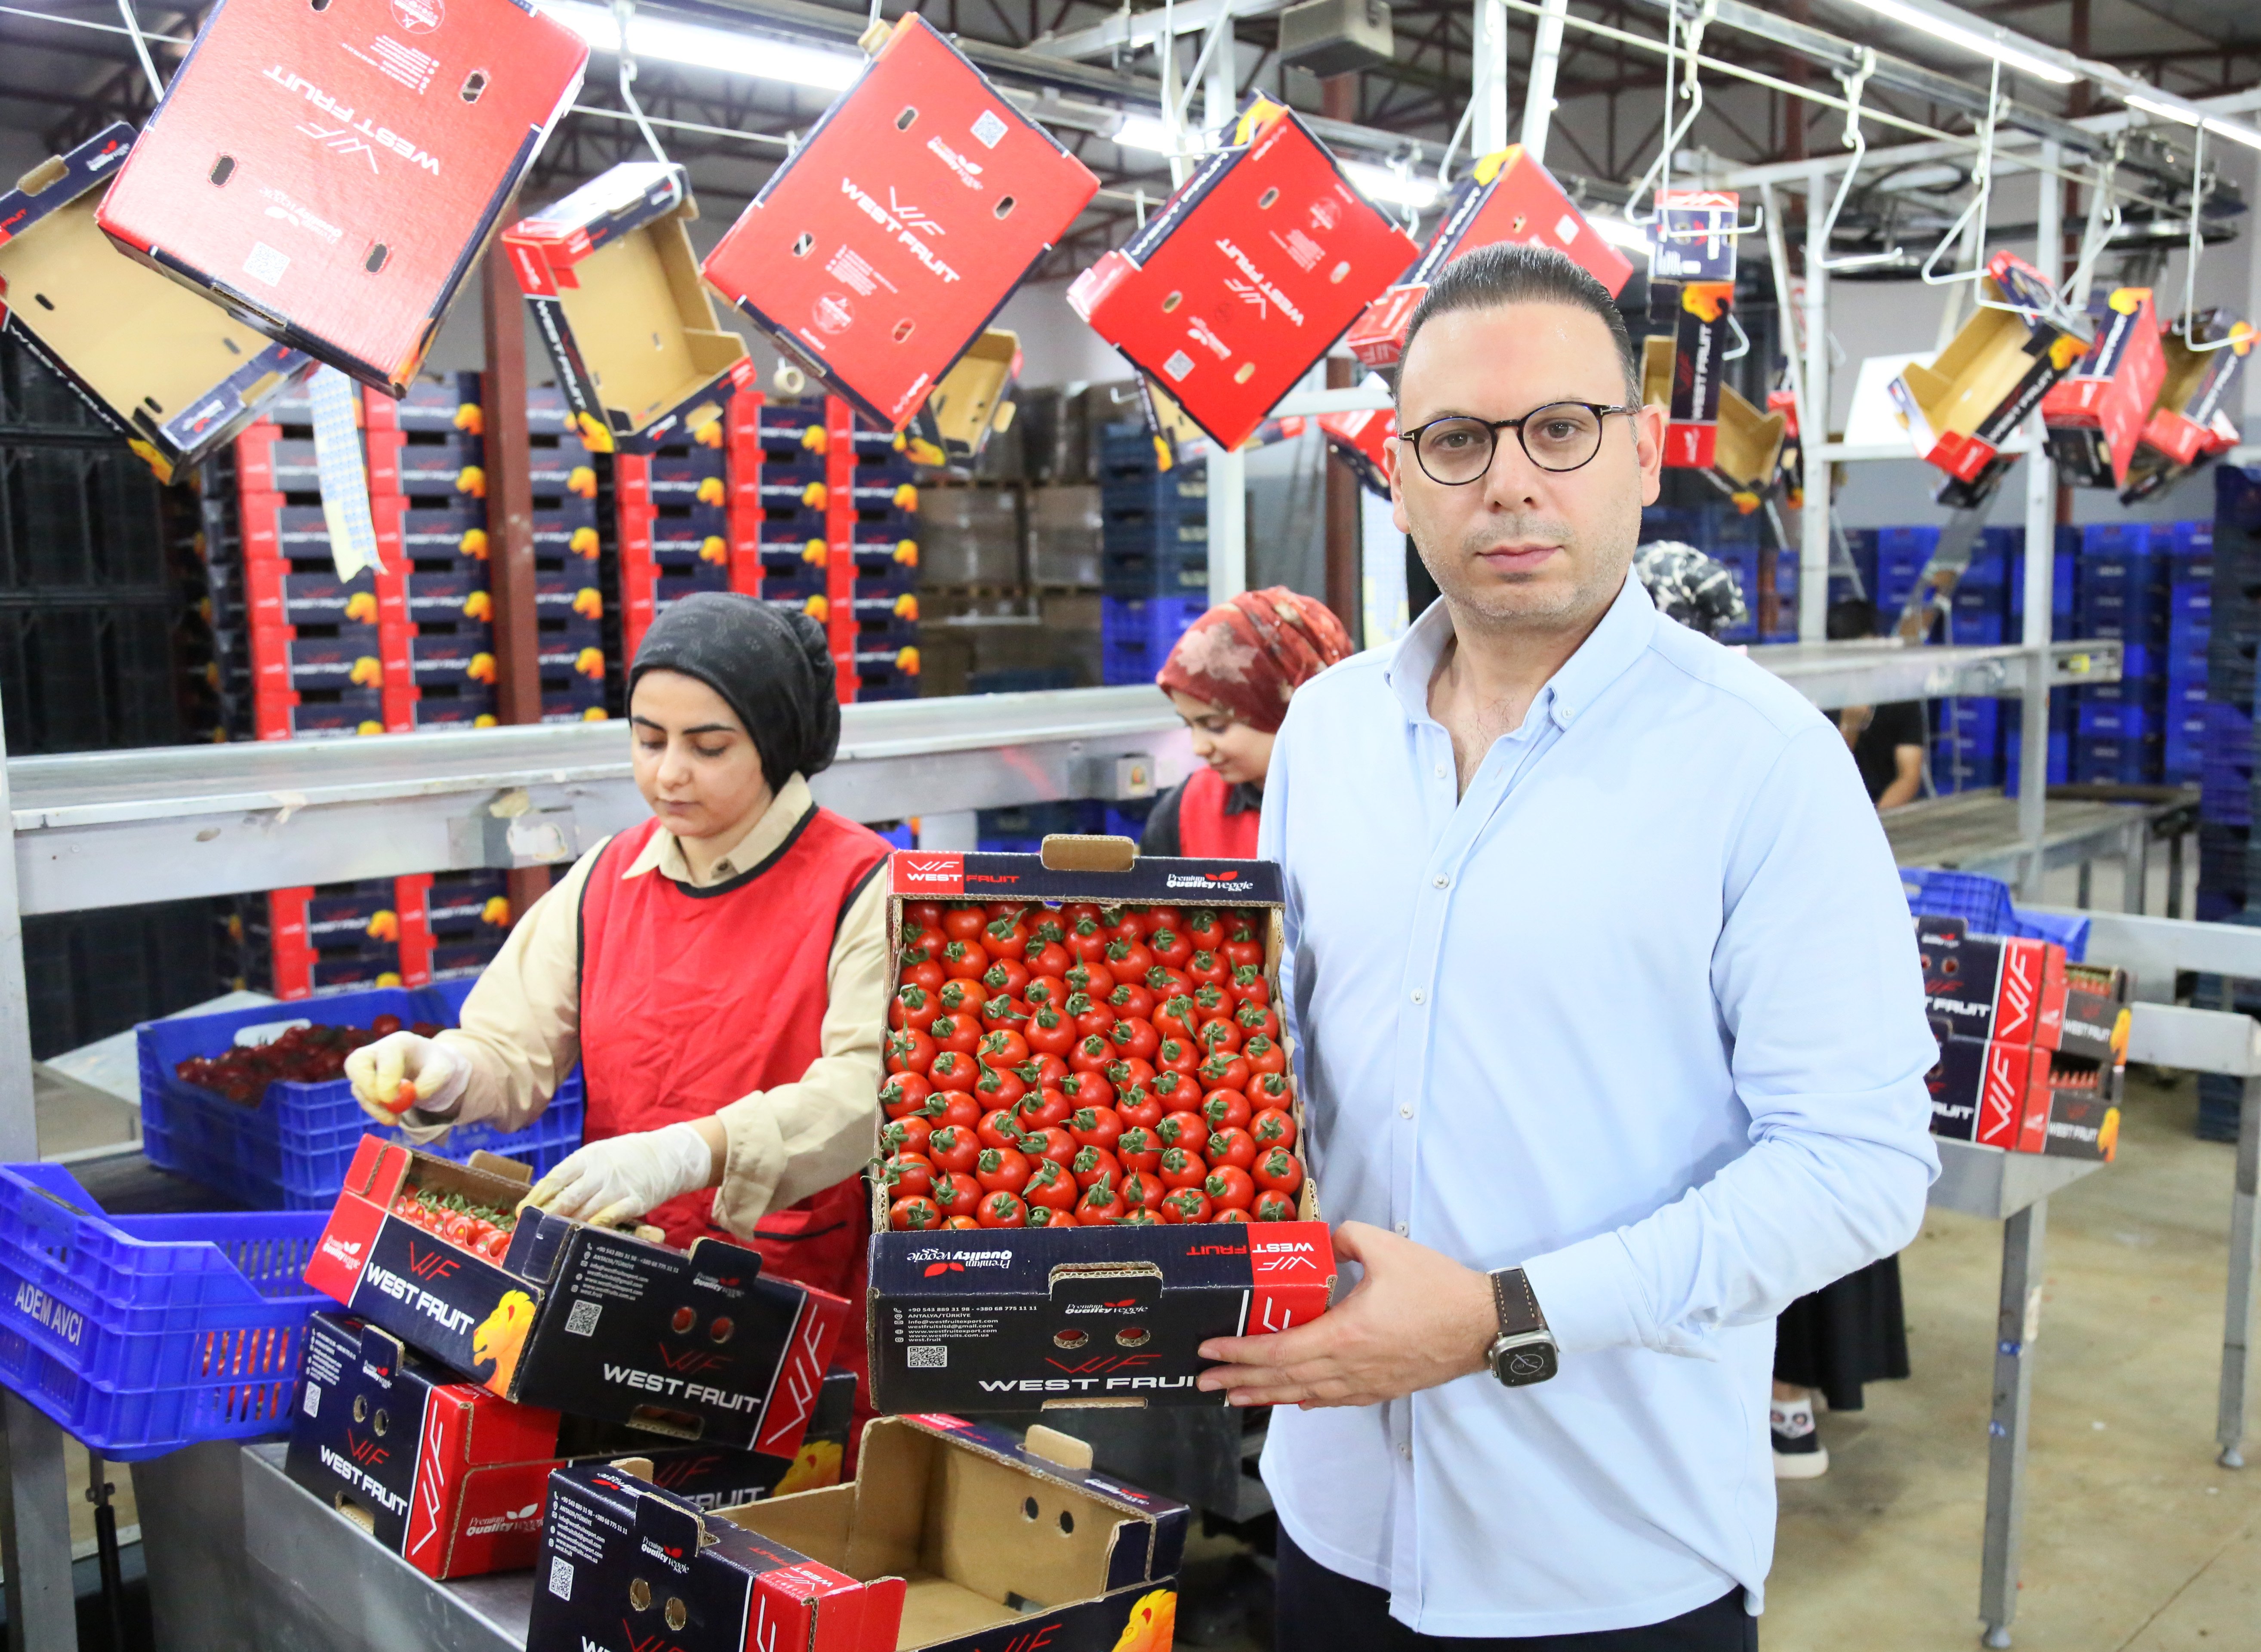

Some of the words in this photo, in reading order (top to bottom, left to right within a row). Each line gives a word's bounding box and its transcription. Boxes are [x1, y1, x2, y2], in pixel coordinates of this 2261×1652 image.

[262, 60, 355, 124] FRUIT
[352, 113, 444, 176] WEST
[836, 176, 905, 237] WEST
[896, 229, 961, 288] FRUIT
[1213, 233, 1266, 285] FRUIT
[1256, 277, 1308, 328] WEST
[907, 861, 959, 871] WF
[966, 875, 1020, 883] FRUIT
[1166, 880, 1216, 889] Quality
[1217, 881, 1254, 891] veggie
[2000, 944, 2033, 1037] WF
[1932, 995, 1991, 1017] FRUIT
[1982, 1047, 2015, 1141] WF
[907, 1248, 951, 1263] veggie
[953, 1250, 1012, 1260] Quality
[1186, 1245, 1247, 1255] FRUIT
[1252, 1242, 1314, 1253] WEST
[410, 1241, 460, 1281] WF
[965, 1259, 1010, 1269] Premium
[1257, 1256, 1317, 1270] WF
[692, 1277, 724, 1291] Quality
[361, 1261, 420, 1306] WEST
[413, 1290, 475, 1337] FRUIT
[15, 1282, 51, 1325] ADEM
[51, 1307, 83, 1346] AVCI
[1113, 1306, 1149, 1315] veggie
[766, 1304, 825, 1446] WF
[1045, 1355, 1162, 1374] WF
[601, 1363, 684, 1396] WEST
[684, 1382, 761, 1415] FRUIT
[978, 1378, 1099, 1392] WEST
[1106, 1375, 1197, 1390] FRUI
[347, 1428, 390, 1466] WF
[320, 1444, 362, 1489] WEST
[362, 1473, 408, 1516] FRUIT
[412, 1399, 444, 1556] WF
[465, 1520, 515, 1537] Quality
[643, 1536, 664, 1552] Premium
[641, 1544, 668, 1563] Quality
[668, 1557, 690, 1574] veggie
[789, 1565, 834, 1587] WEST
